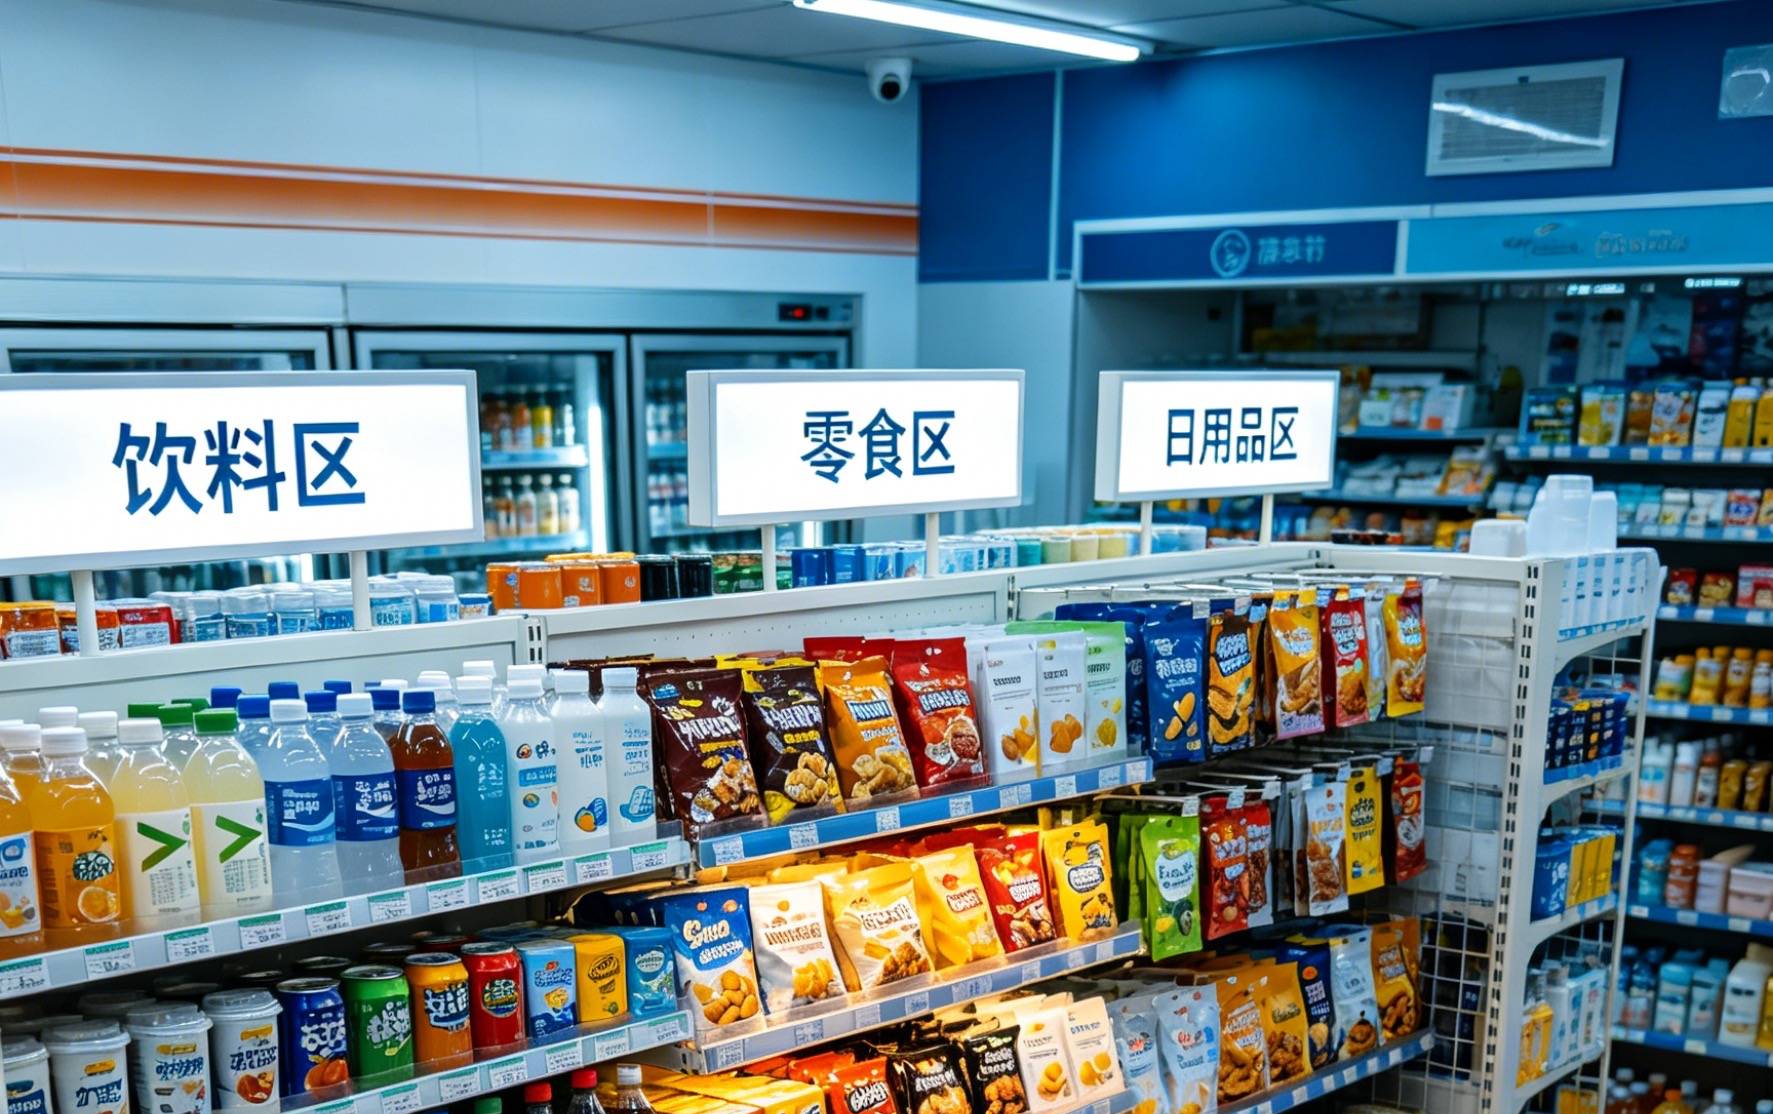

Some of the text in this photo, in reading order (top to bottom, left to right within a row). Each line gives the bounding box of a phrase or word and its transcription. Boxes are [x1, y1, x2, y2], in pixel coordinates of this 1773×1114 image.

[112, 419, 365, 516] 饮料区
[801, 408, 955, 483] 零食区
[1167, 406, 1299, 466] 日用品区
